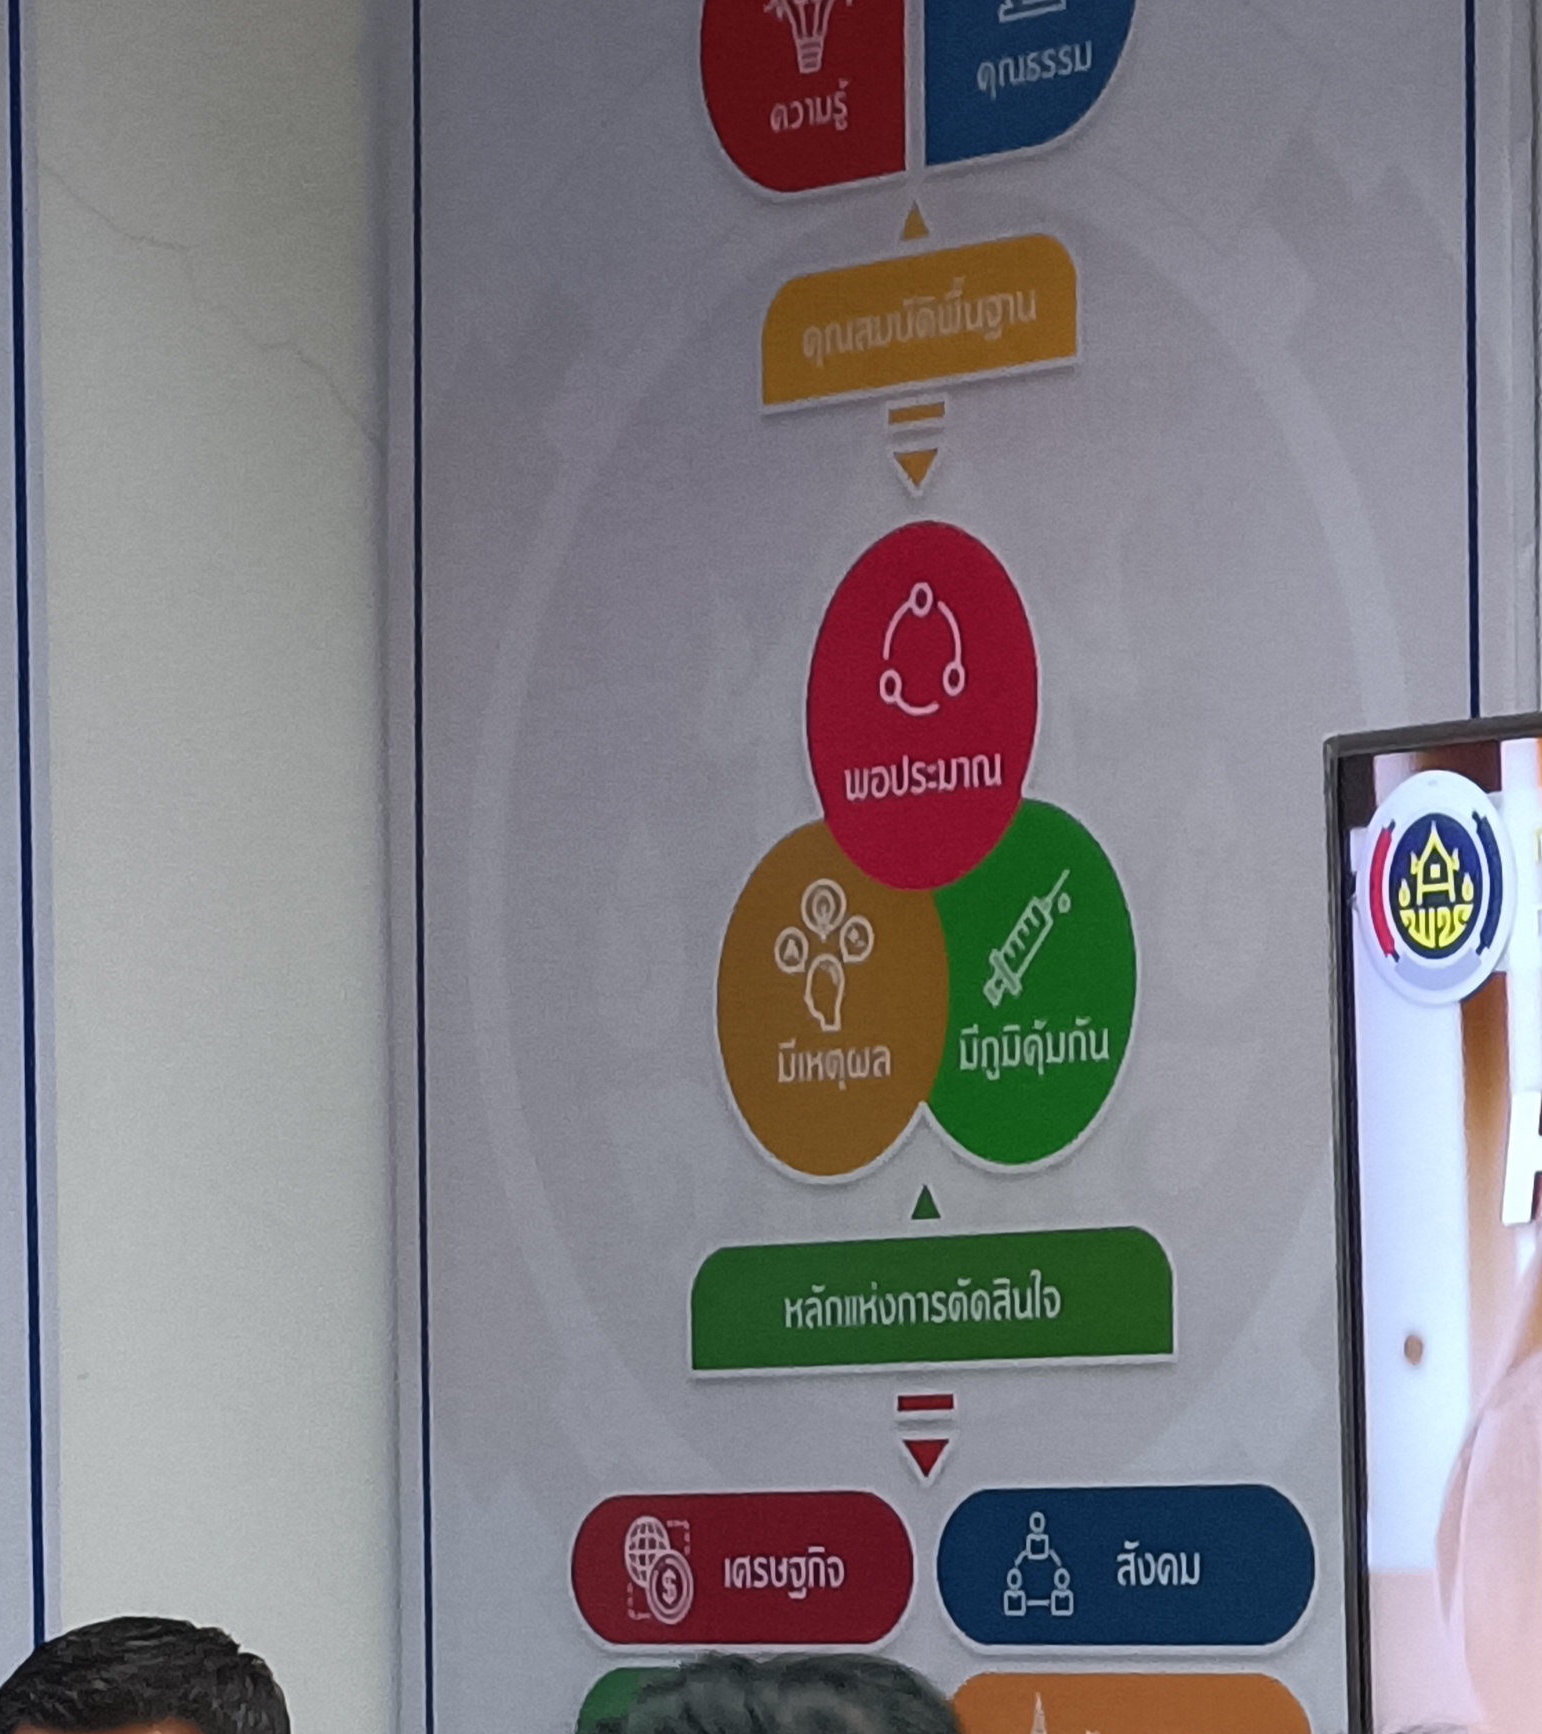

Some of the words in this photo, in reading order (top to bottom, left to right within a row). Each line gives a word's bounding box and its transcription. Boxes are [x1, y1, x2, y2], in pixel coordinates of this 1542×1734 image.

[976, 40, 1093, 99] คุณธรรม
[770, 77, 849, 133] ความรู้
[802, 275, 1037, 368] คุณสมบัติพื้นฐาน
[844, 751, 1002, 802] พอประมาณ
[777, 1036, 891, 1090] มีเหตุผล
[959, 1016, 1109, 1080] มีภูมิคุ้มกัน
[784, 1269, 1061, 1329] หลักแห่งการตัดสินใจ
[723, 1546, 846, 1599] เศรษฐกิจ
[1115, 1540, 1201, 1586] สังคม
